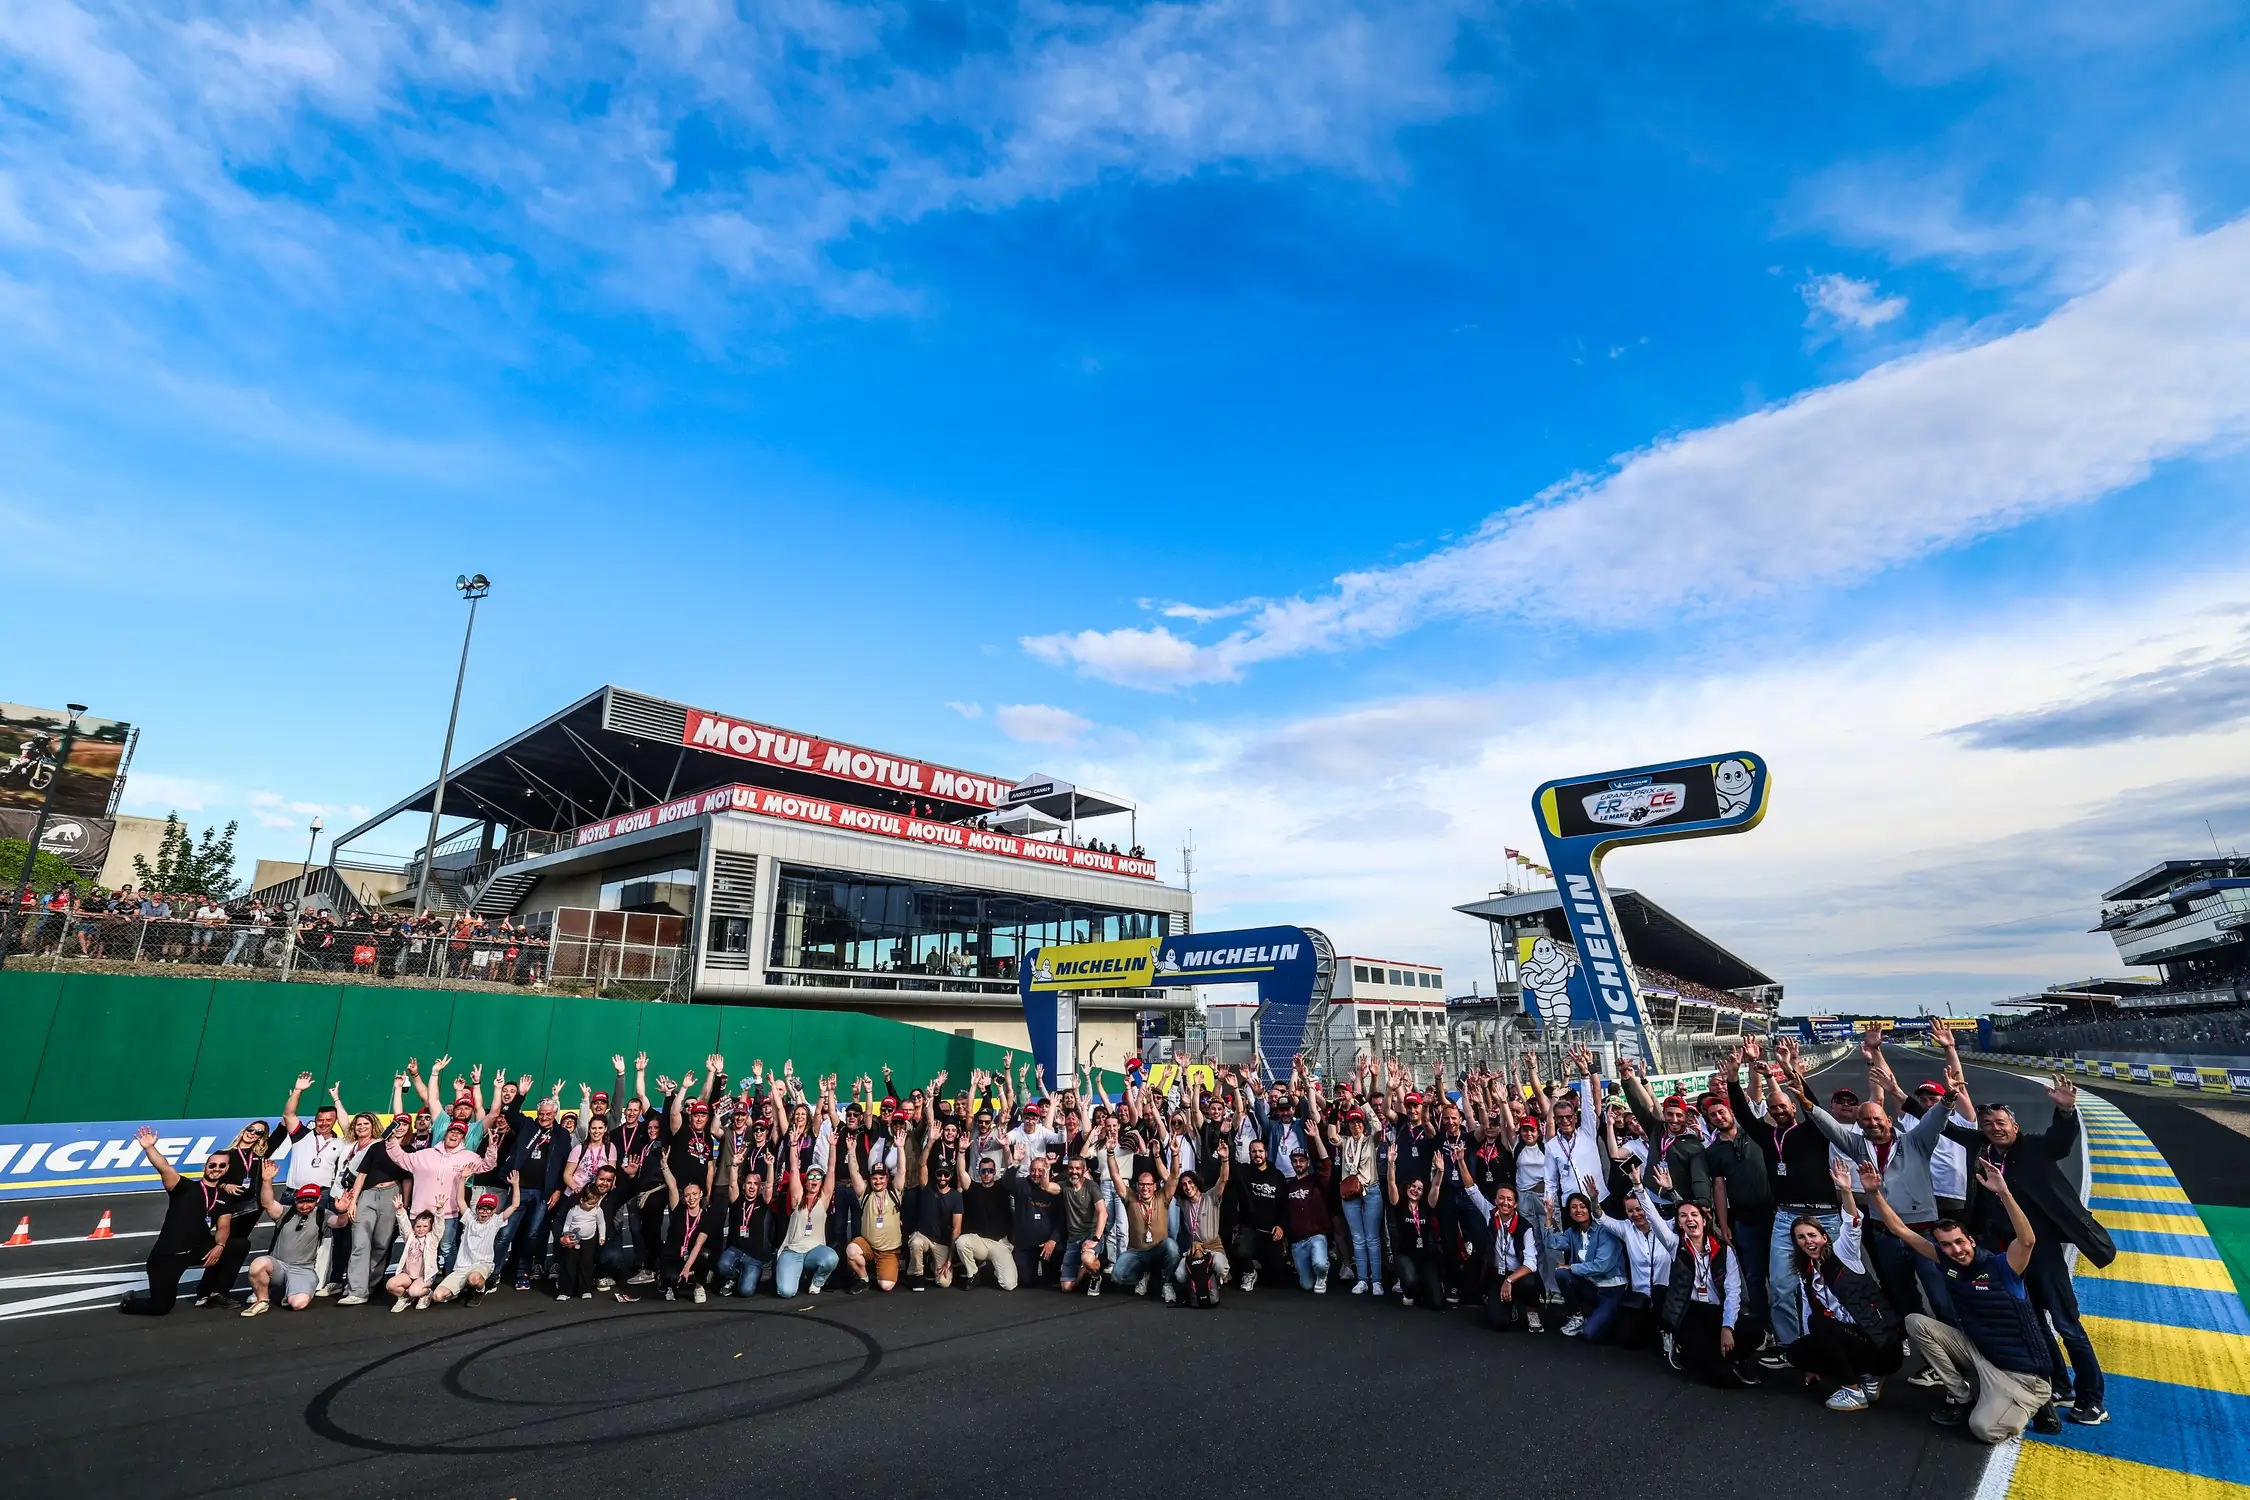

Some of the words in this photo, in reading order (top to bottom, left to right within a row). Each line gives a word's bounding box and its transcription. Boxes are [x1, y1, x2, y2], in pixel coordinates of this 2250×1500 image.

[692, 717, 814, 767] MOTUL
[822, 747, 923, 790] MOTUL
[1622, 779, 1648, 787] MICHELIN
[1593, 791, 1677, 816] FRANCE
[1600, 792, 1632, 801] GRAND
[1633, 787, 1656, 796] PRIX
[1609, 812, 1629, 820] MANS
[578, 823, 610, 845] MOTUL
[615, 811, 651, 835] MOTUL
[657, 799, 697, 825] MOTUL
[762, 794, 832, 822] MOTUL
[838, 809, 901, 834] MOTUL
[907, 821, 963, 844] MOTUL
[968, 832, 1019, 854] MOTUL
[1022, 843, 1069, 862] MOTUL
[1073, 852, 1114, 870] MOTUL
[1118, 859, 1156, 876] MOTUL
[2218, 915, 2244, 927] PORSCHE
[1182, 943, 1300, 967] MICHELIN
[1055, 957, 1147, 976] MICHELIN
